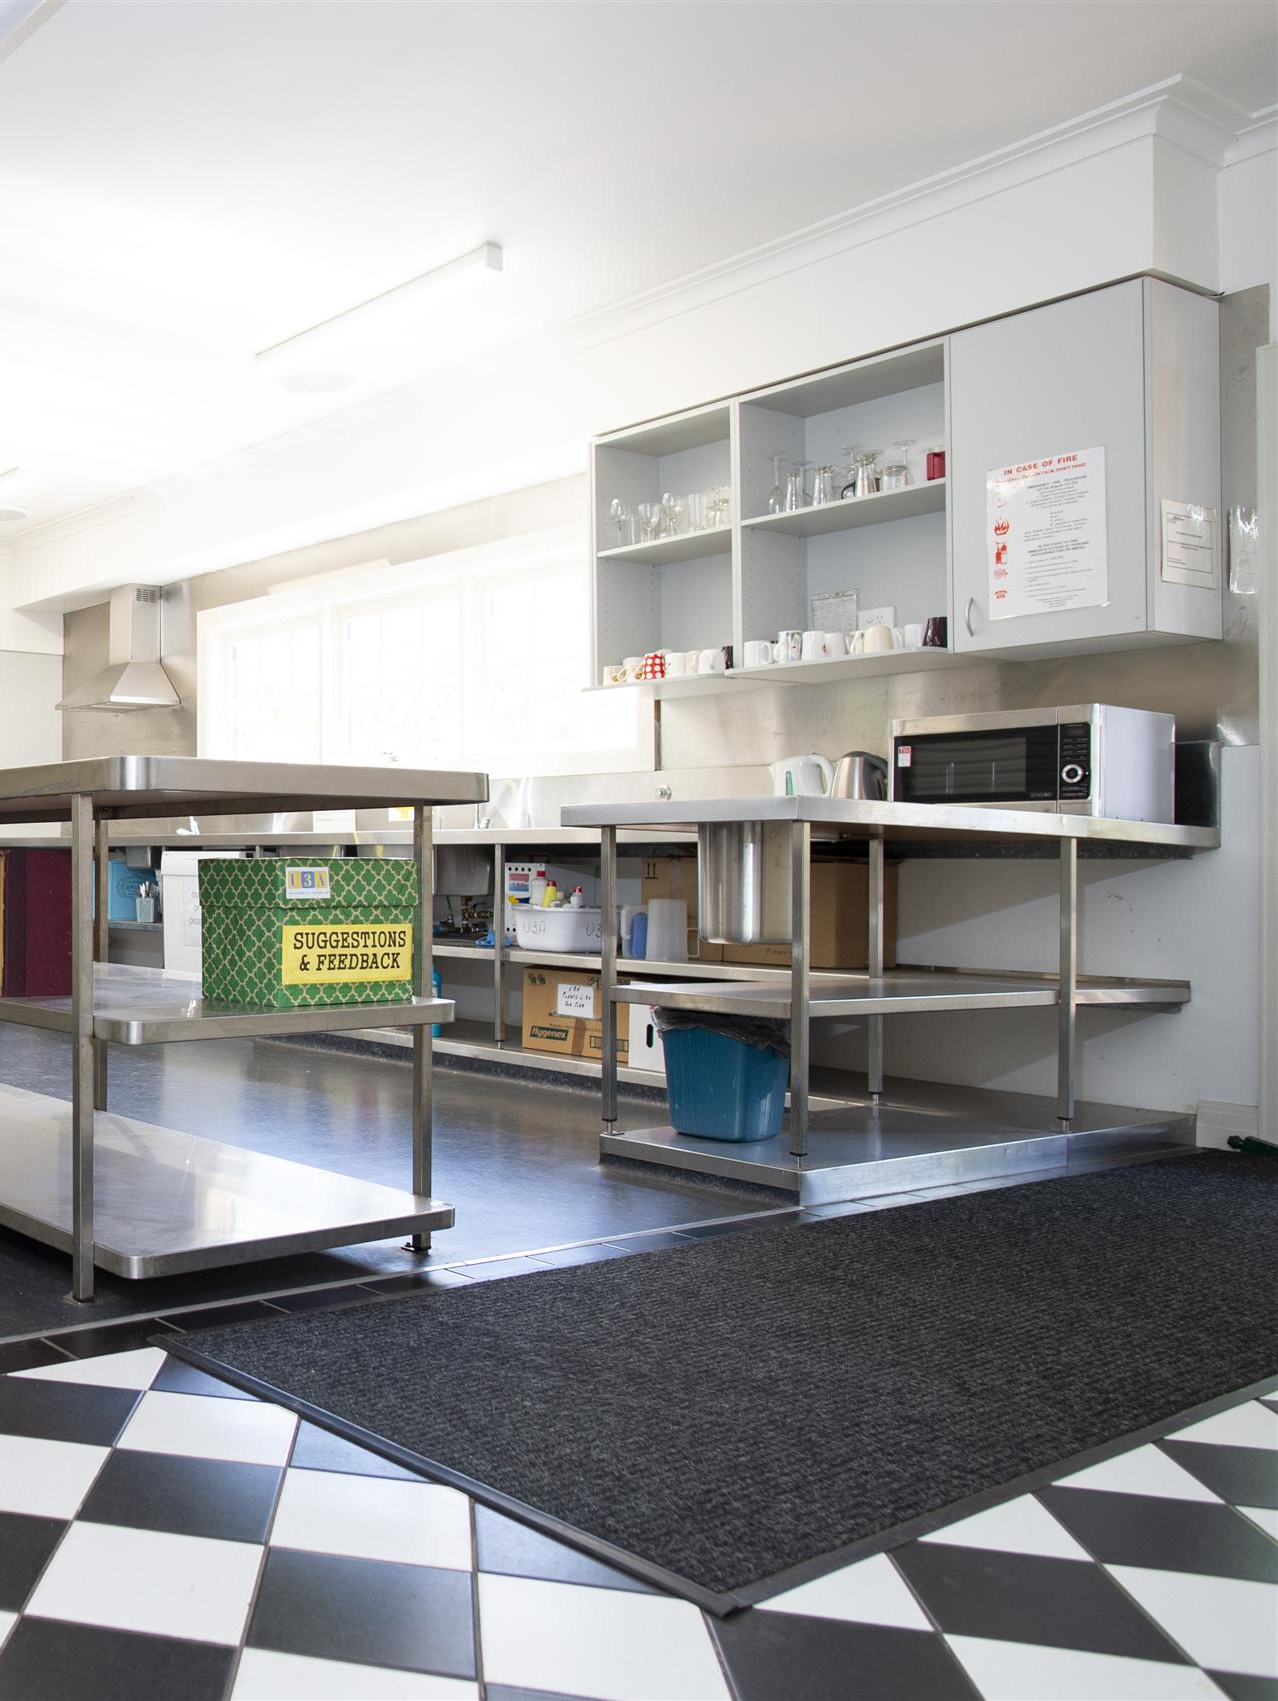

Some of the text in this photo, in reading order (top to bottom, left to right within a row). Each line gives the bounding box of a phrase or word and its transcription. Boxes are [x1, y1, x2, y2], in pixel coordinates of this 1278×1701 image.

[1016, 463, 1038, 473] CASE
[1057, 454, 1078, 464] FIRE
[290, 871, 327, 889] U3A
[523, 920, 546, 934] U3A
[586, 923, 602, 938] U3
[293, 931, 407, 950] SUGGESTIONS
[299, 952, 401, 971] & FEEDBACK
[531, 1027, 567, 1039] Hygenex
